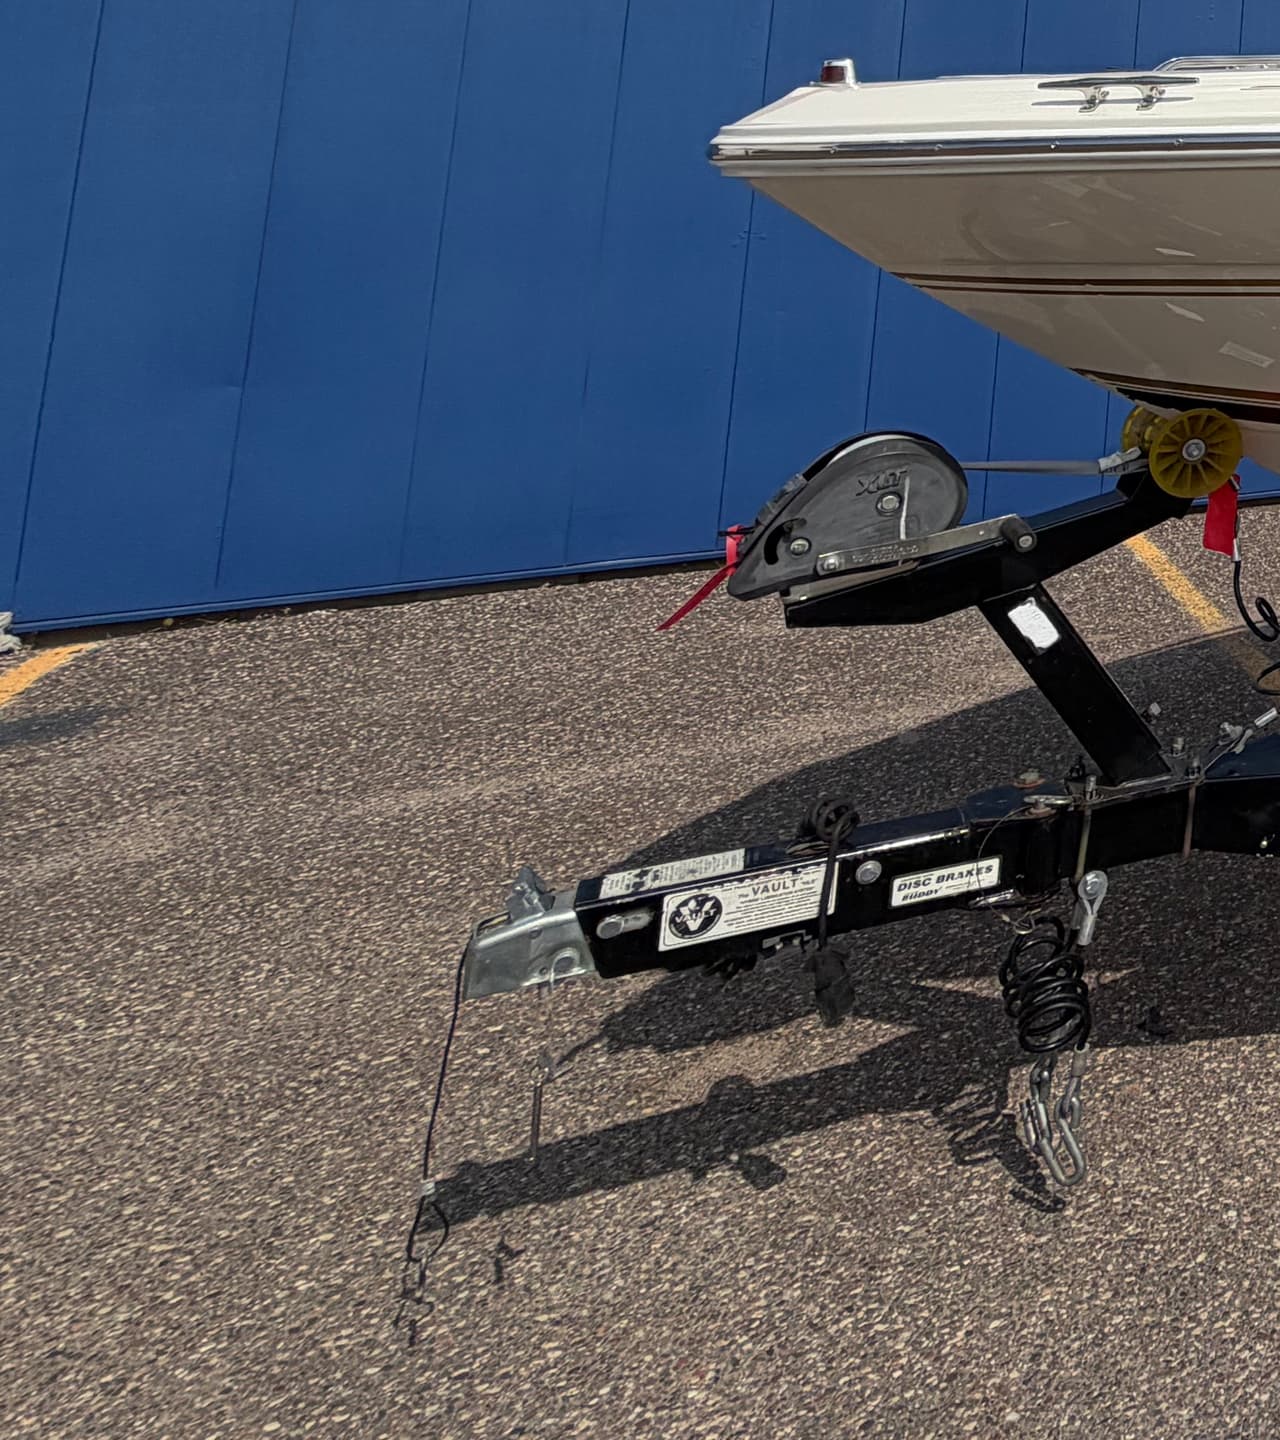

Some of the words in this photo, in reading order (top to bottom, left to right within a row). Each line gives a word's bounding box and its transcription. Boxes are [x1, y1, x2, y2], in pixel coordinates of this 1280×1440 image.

[751, 879, 798, 897] VAULT
[896, 877, 932, 893] DISC
[935, 864, 994, 885] BRAKES
